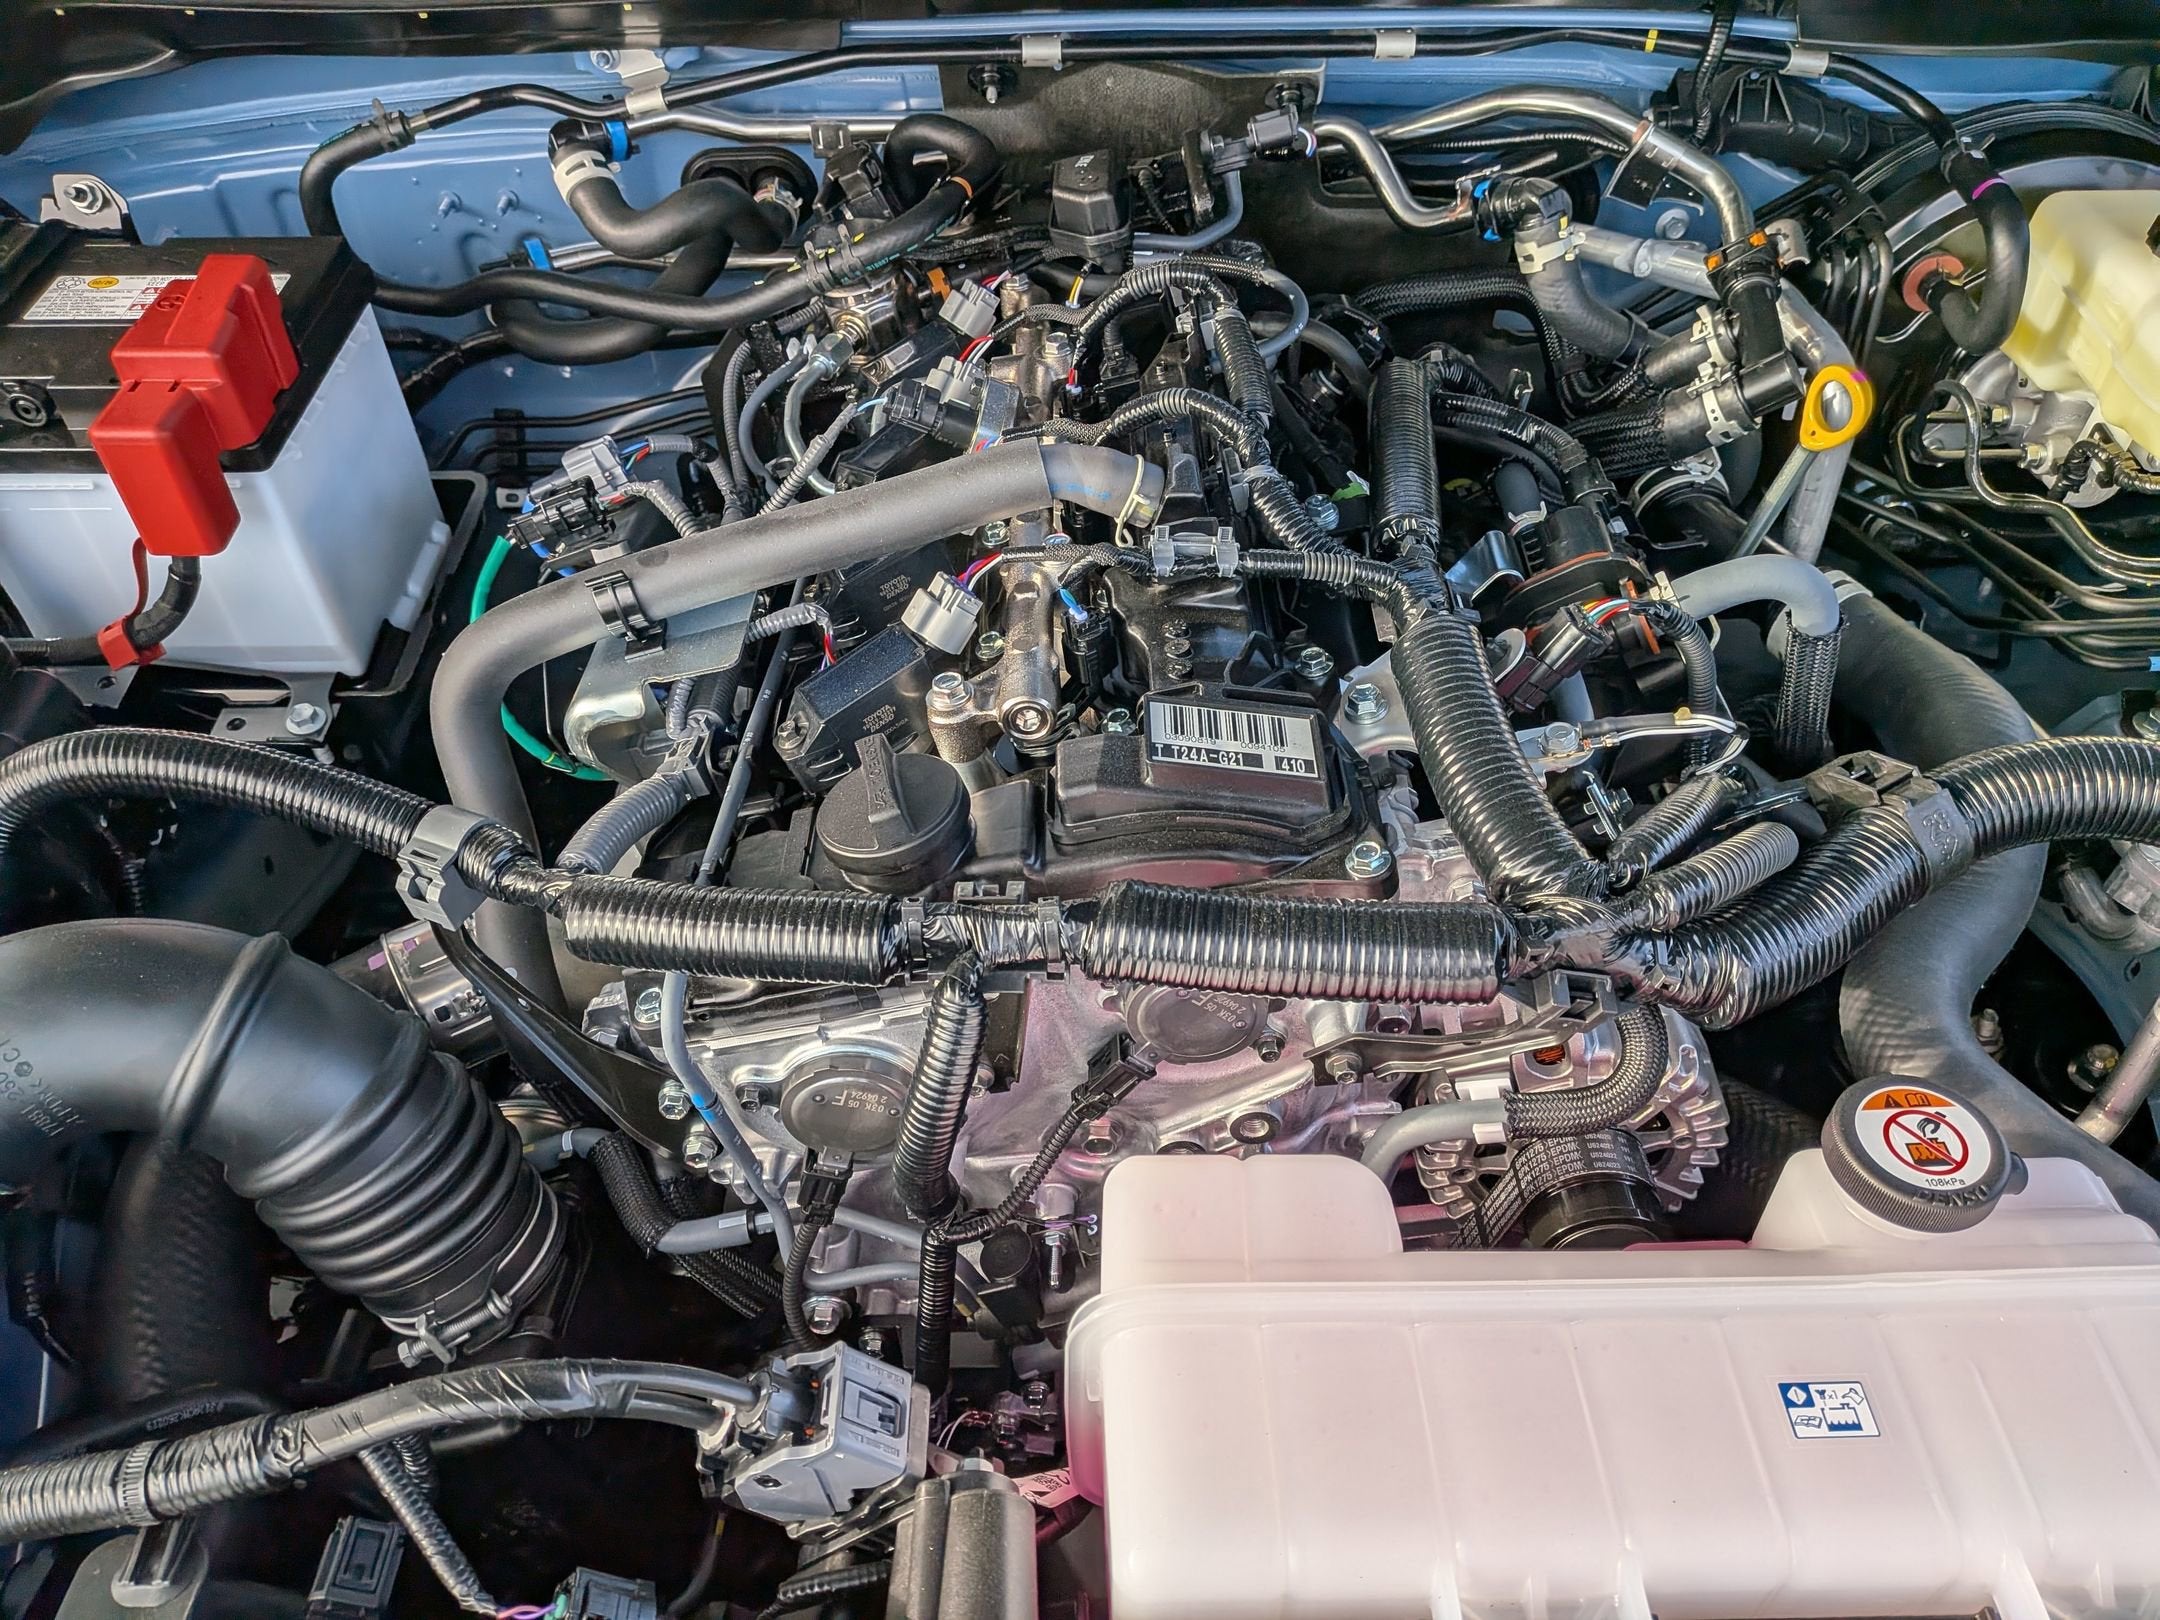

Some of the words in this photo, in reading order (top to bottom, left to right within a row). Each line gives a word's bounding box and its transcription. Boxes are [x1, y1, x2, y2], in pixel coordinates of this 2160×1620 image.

[879, 574, 906, 591] TOYOTA
[863, 704, 892, 724] TOYOTA
[870, 713, 895, 732] DENSO
[1154, 743, 1164, 758] T
[1171, 745, 1244, 767] T24A-G21
[1281, 758, 1306, 774] 410
[831, 1090, 848, 1106] F
[1517, 1152, 1547, 1180] 6PK1275
[1520, 1162, 1550, 1189] 6PK1275
[1924, 1177, 1967, 1188] 108kPa
[1912, 1184, 1991, 1207] DENSO
